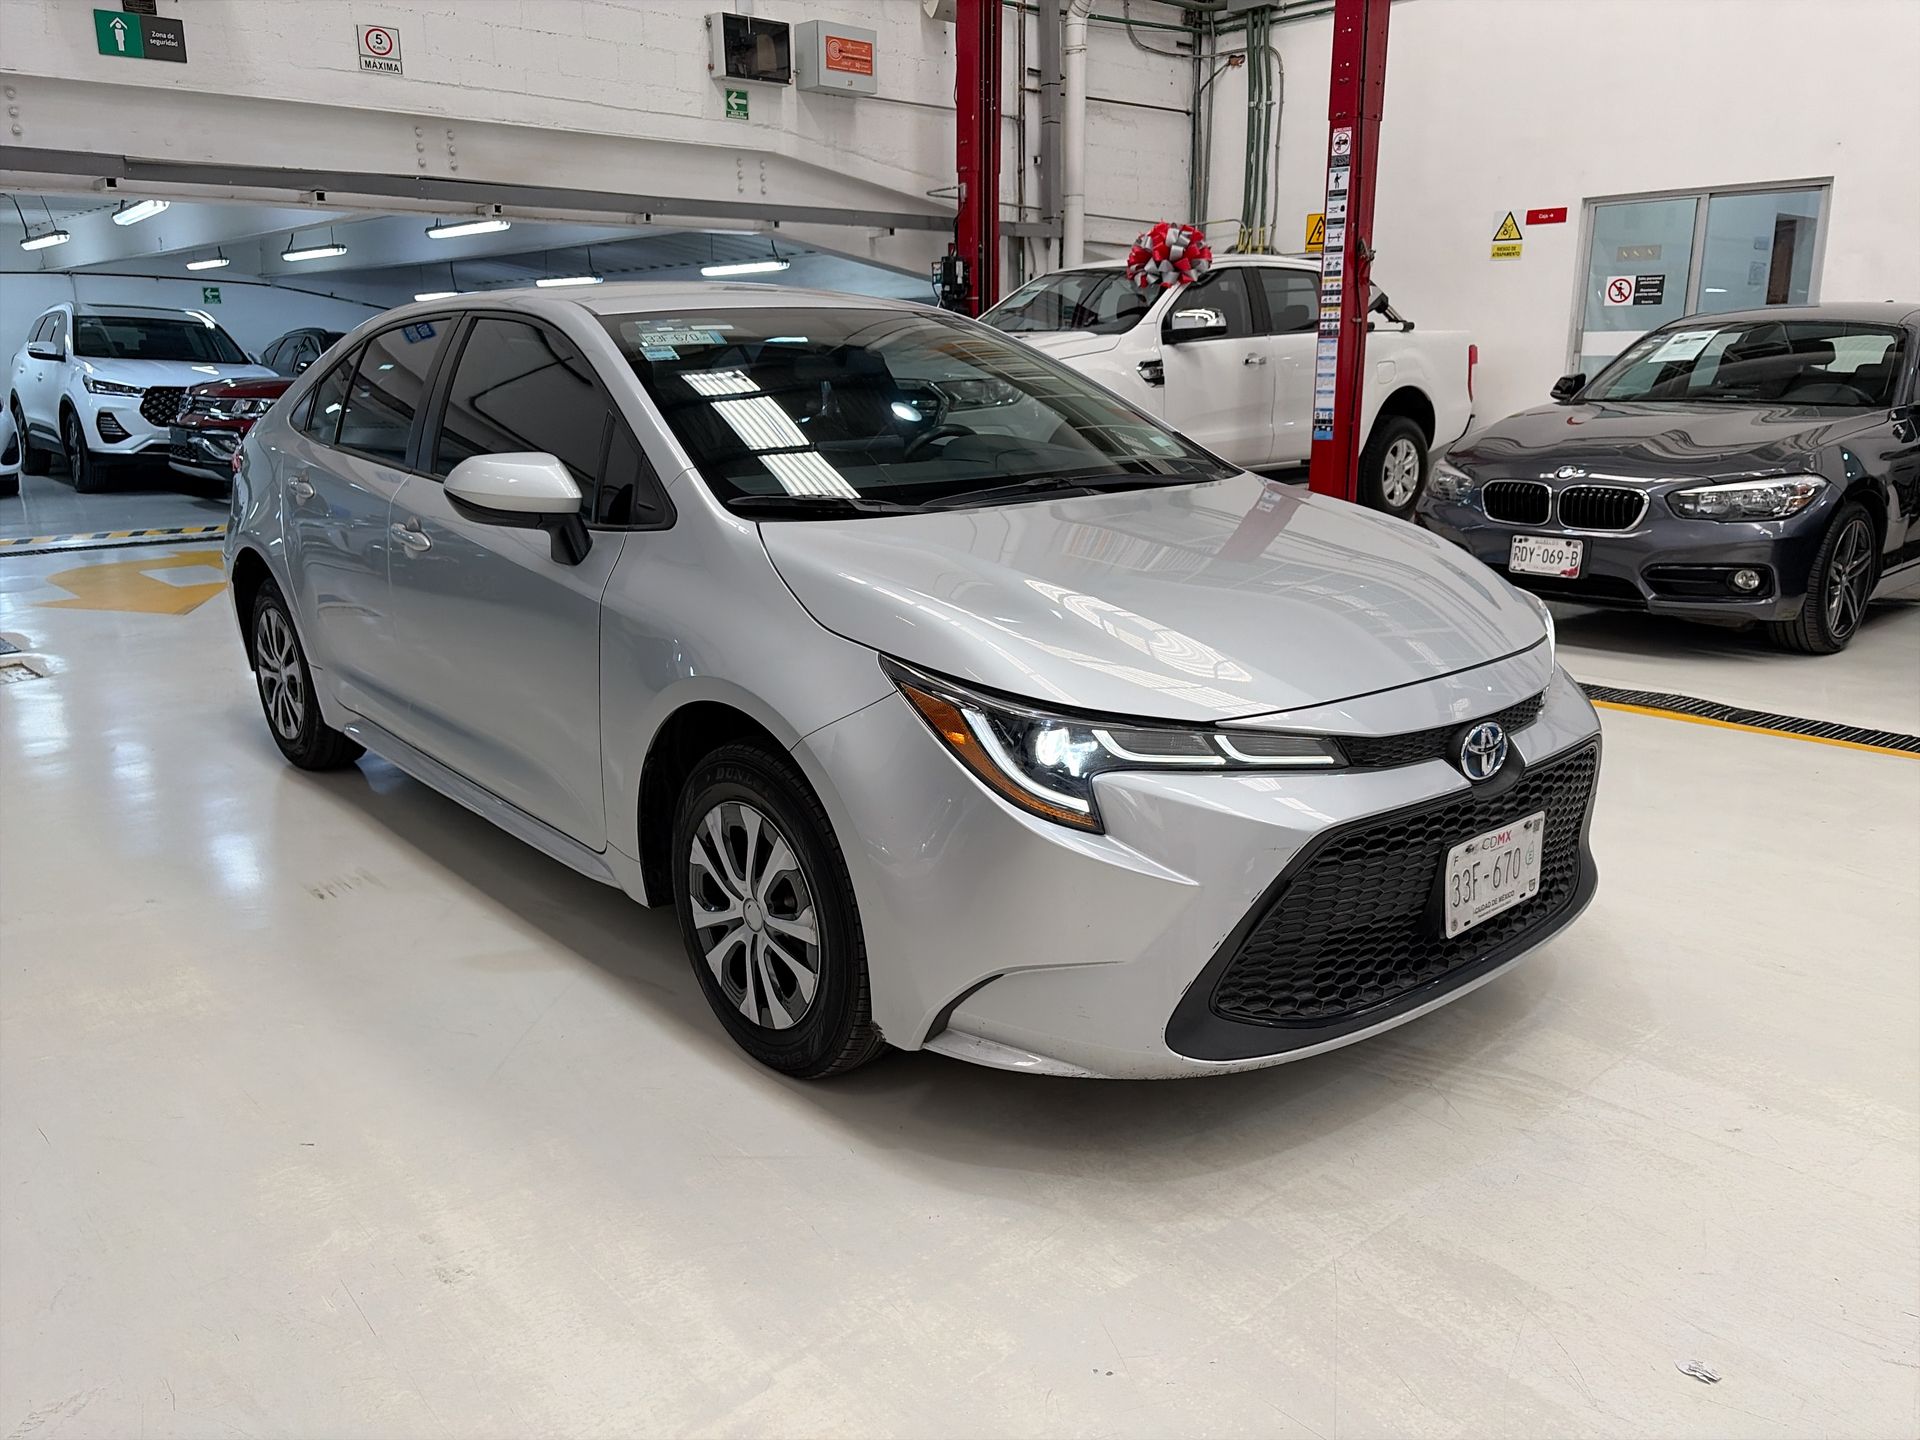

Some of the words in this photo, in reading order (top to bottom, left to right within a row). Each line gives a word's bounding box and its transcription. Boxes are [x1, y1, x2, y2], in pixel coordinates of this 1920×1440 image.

[150, 39, 178, 47] seguridad
[375, 33, 383, 45] 5
[364, 58, 400, 72] MÁXIMA
[1513, 545, 1579, 567] RDY-069-B
[1482, 830, 1512, 850] CDMX
[1452, 847, 1521, 908] 33F-670
